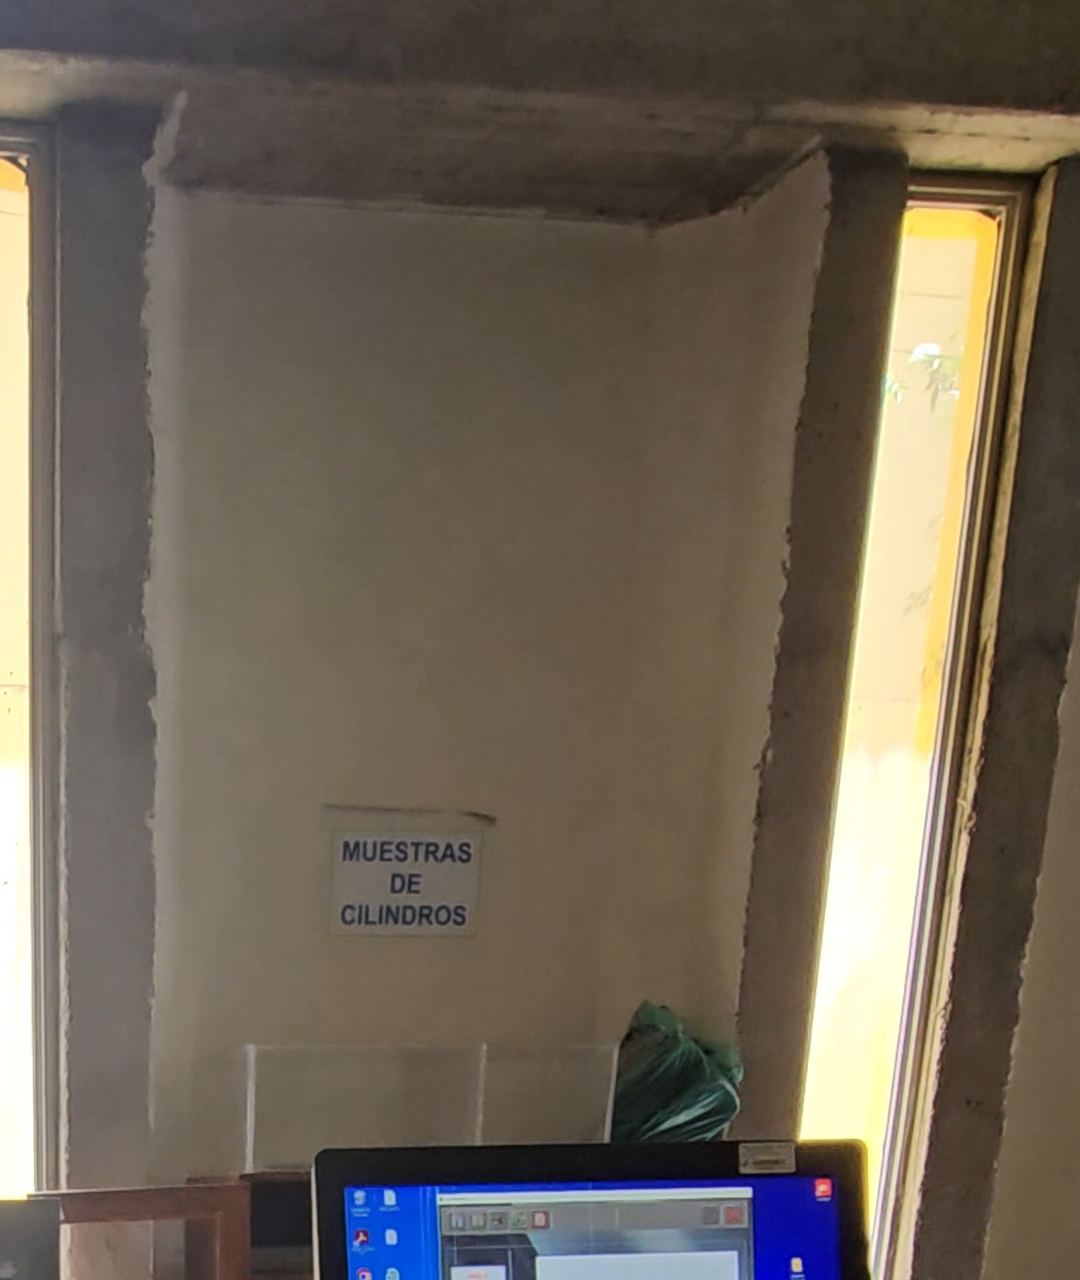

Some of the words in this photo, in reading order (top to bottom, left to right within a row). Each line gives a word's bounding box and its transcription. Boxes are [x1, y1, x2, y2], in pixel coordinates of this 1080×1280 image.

[342, 840, 472, 864] MUESTRAS
[390, 873, 422, 894] DE
[340, 904, 466, 926] CILINDROS
